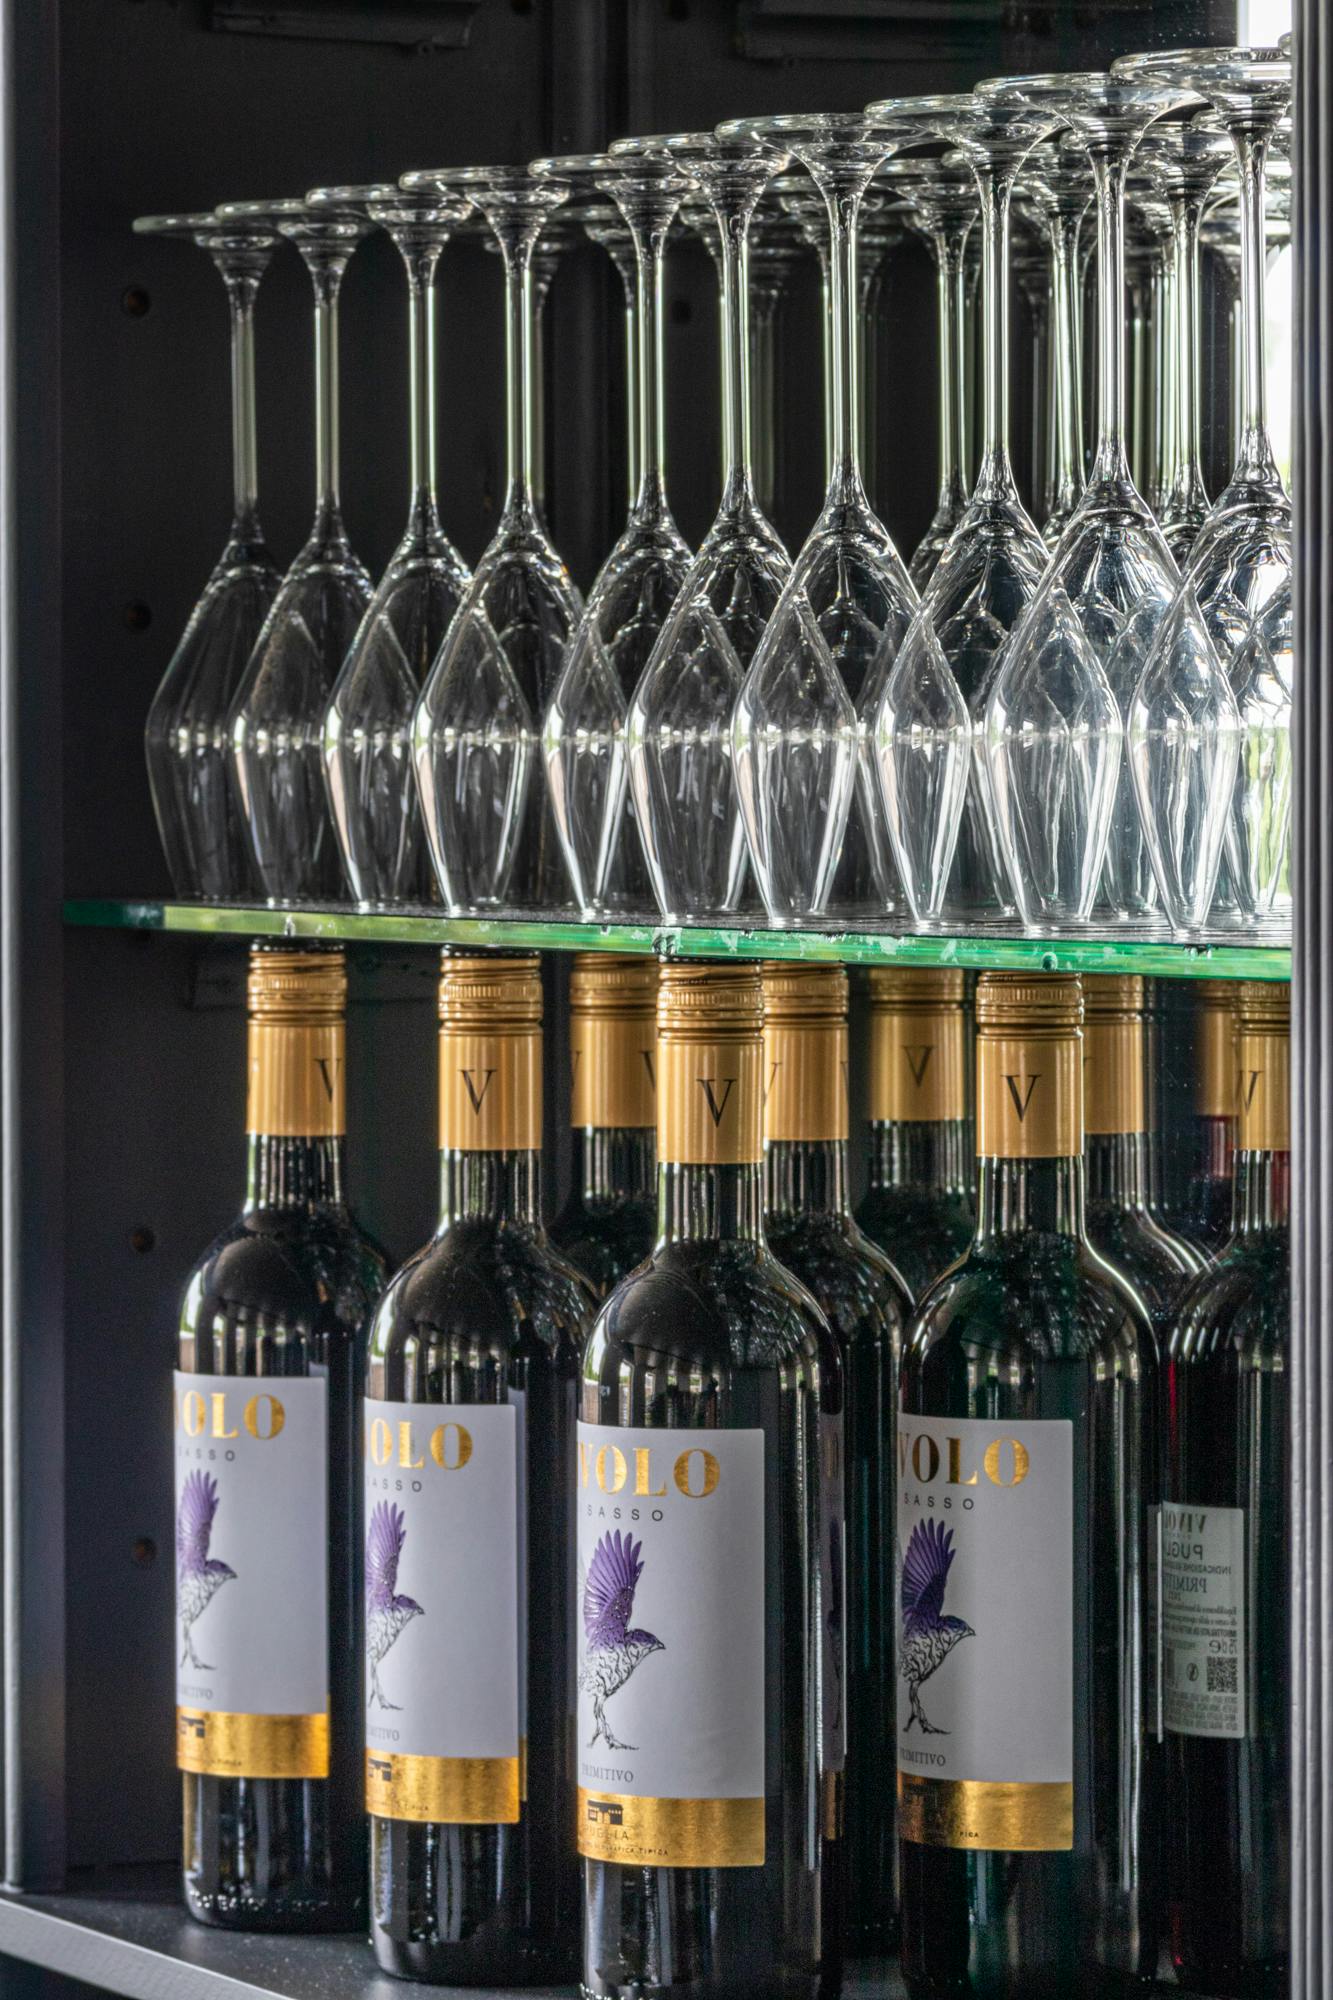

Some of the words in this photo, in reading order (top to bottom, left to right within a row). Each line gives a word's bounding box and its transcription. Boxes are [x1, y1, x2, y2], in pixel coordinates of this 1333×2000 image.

[314, 1058, 342, 1103] V
[903, 1046, 934, 1088] V
[458, 1068, 497, 1115] V
[697, 1078, 737, 1128] V
[1001, 1074, 1041, 1122] V
[371, 1418, 473, 1471] OLO
[586, 1504, 664, 1522] SASSO
